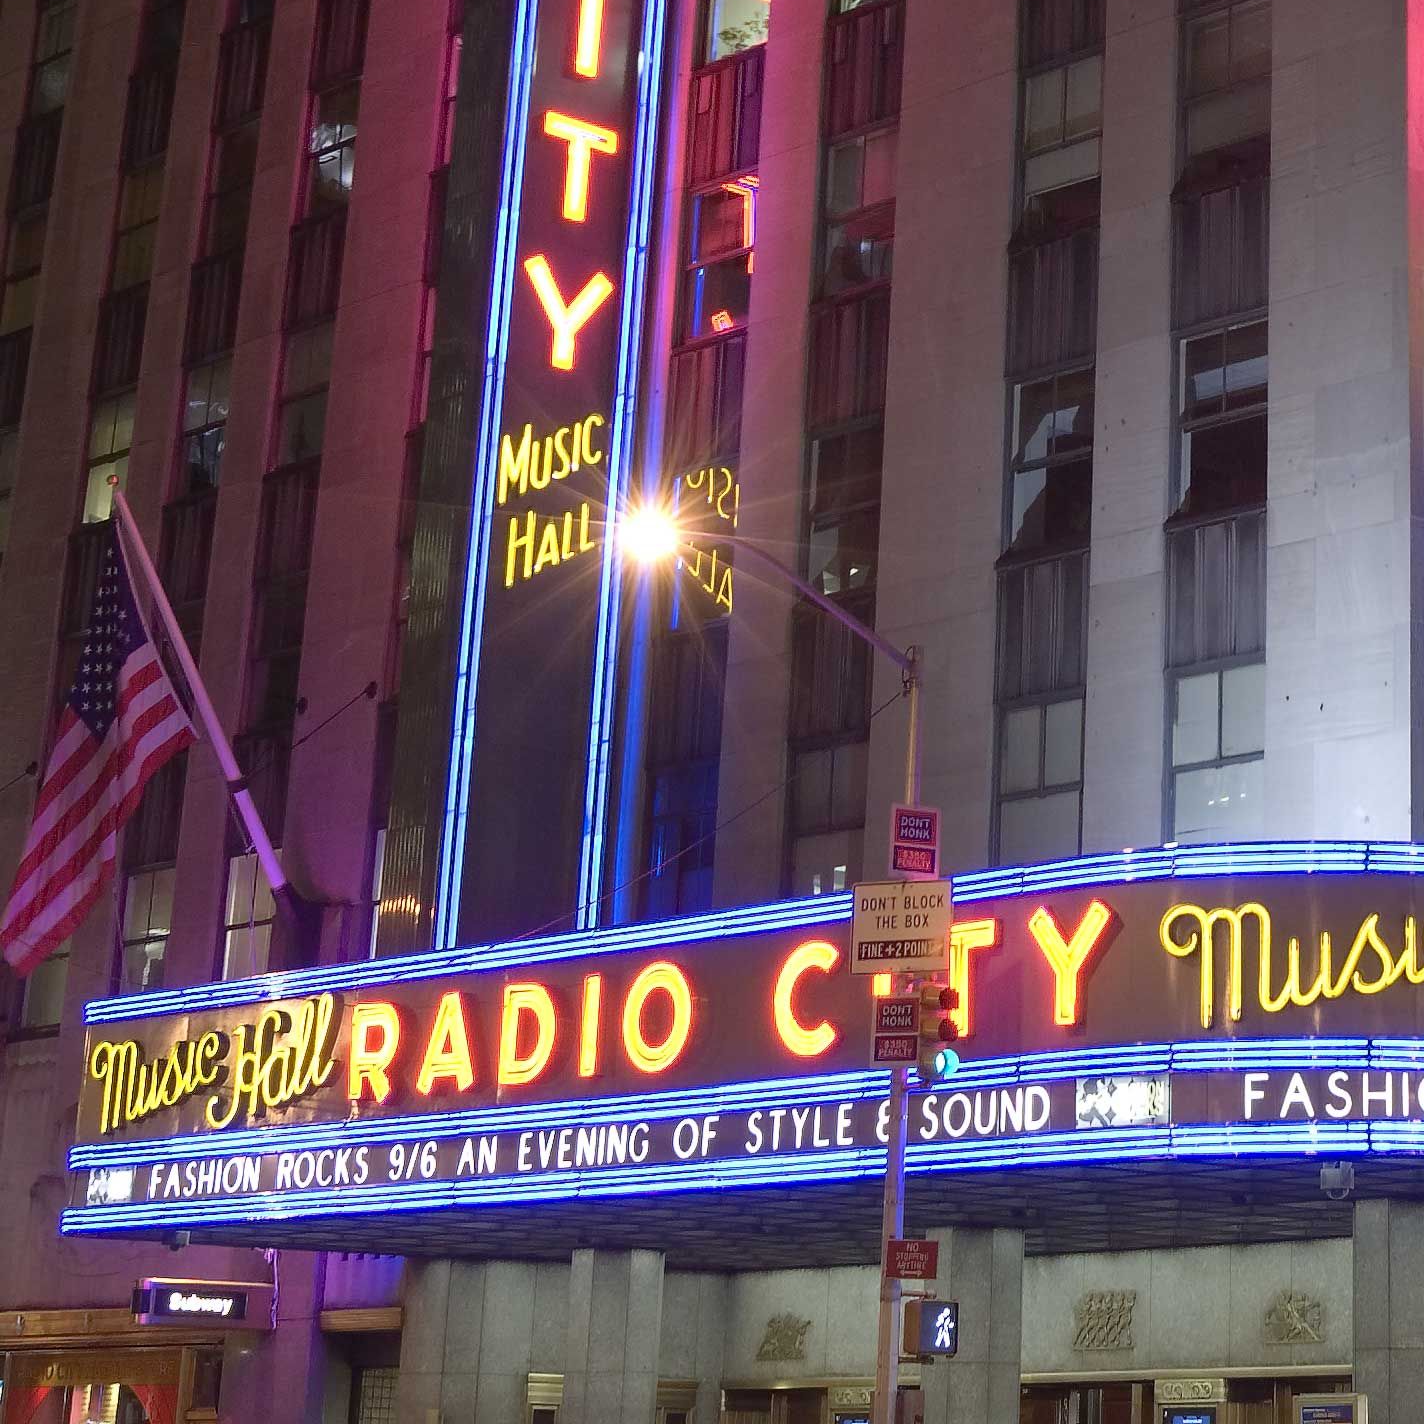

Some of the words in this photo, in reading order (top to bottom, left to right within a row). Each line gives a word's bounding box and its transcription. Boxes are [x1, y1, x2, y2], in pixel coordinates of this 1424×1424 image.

[497, 413, 605, 505] MUSIC
[505, 503, 596, 588] HALL
[900, 827, 931, 839] HONK
[861, 896, 897, 911] DON'T
[904, 894, 944, 910] BLOCK
[875, 915, 898, 929] THE
[905, 914, 929, 927] BOX
[861, 943, 884, 959] FINE
[347, 961, 693, 1105] RADIO
[773, 898, 1112, 1058] CTY
[882, 1016, 912, 1026] HONK
[91, 1031, 219, 1133] Music
[205, 992, 334, 1129] Hall
[149, 1155, 262, 1199] FASHION
[276, 1146, 369, 1190] ROCKS
[388, 1140, 438, 1181] 9/6
[456, 1135, 497, 1176] AN
[517, 1122, 650, 1172] EVENING
[673, 1115, 720, 1159] OF
[745, 1102, 854, 1154] STYLE
[919, 1085, 1050, 1140] SOUND
[168, 1292, 233, 1316] Subway
